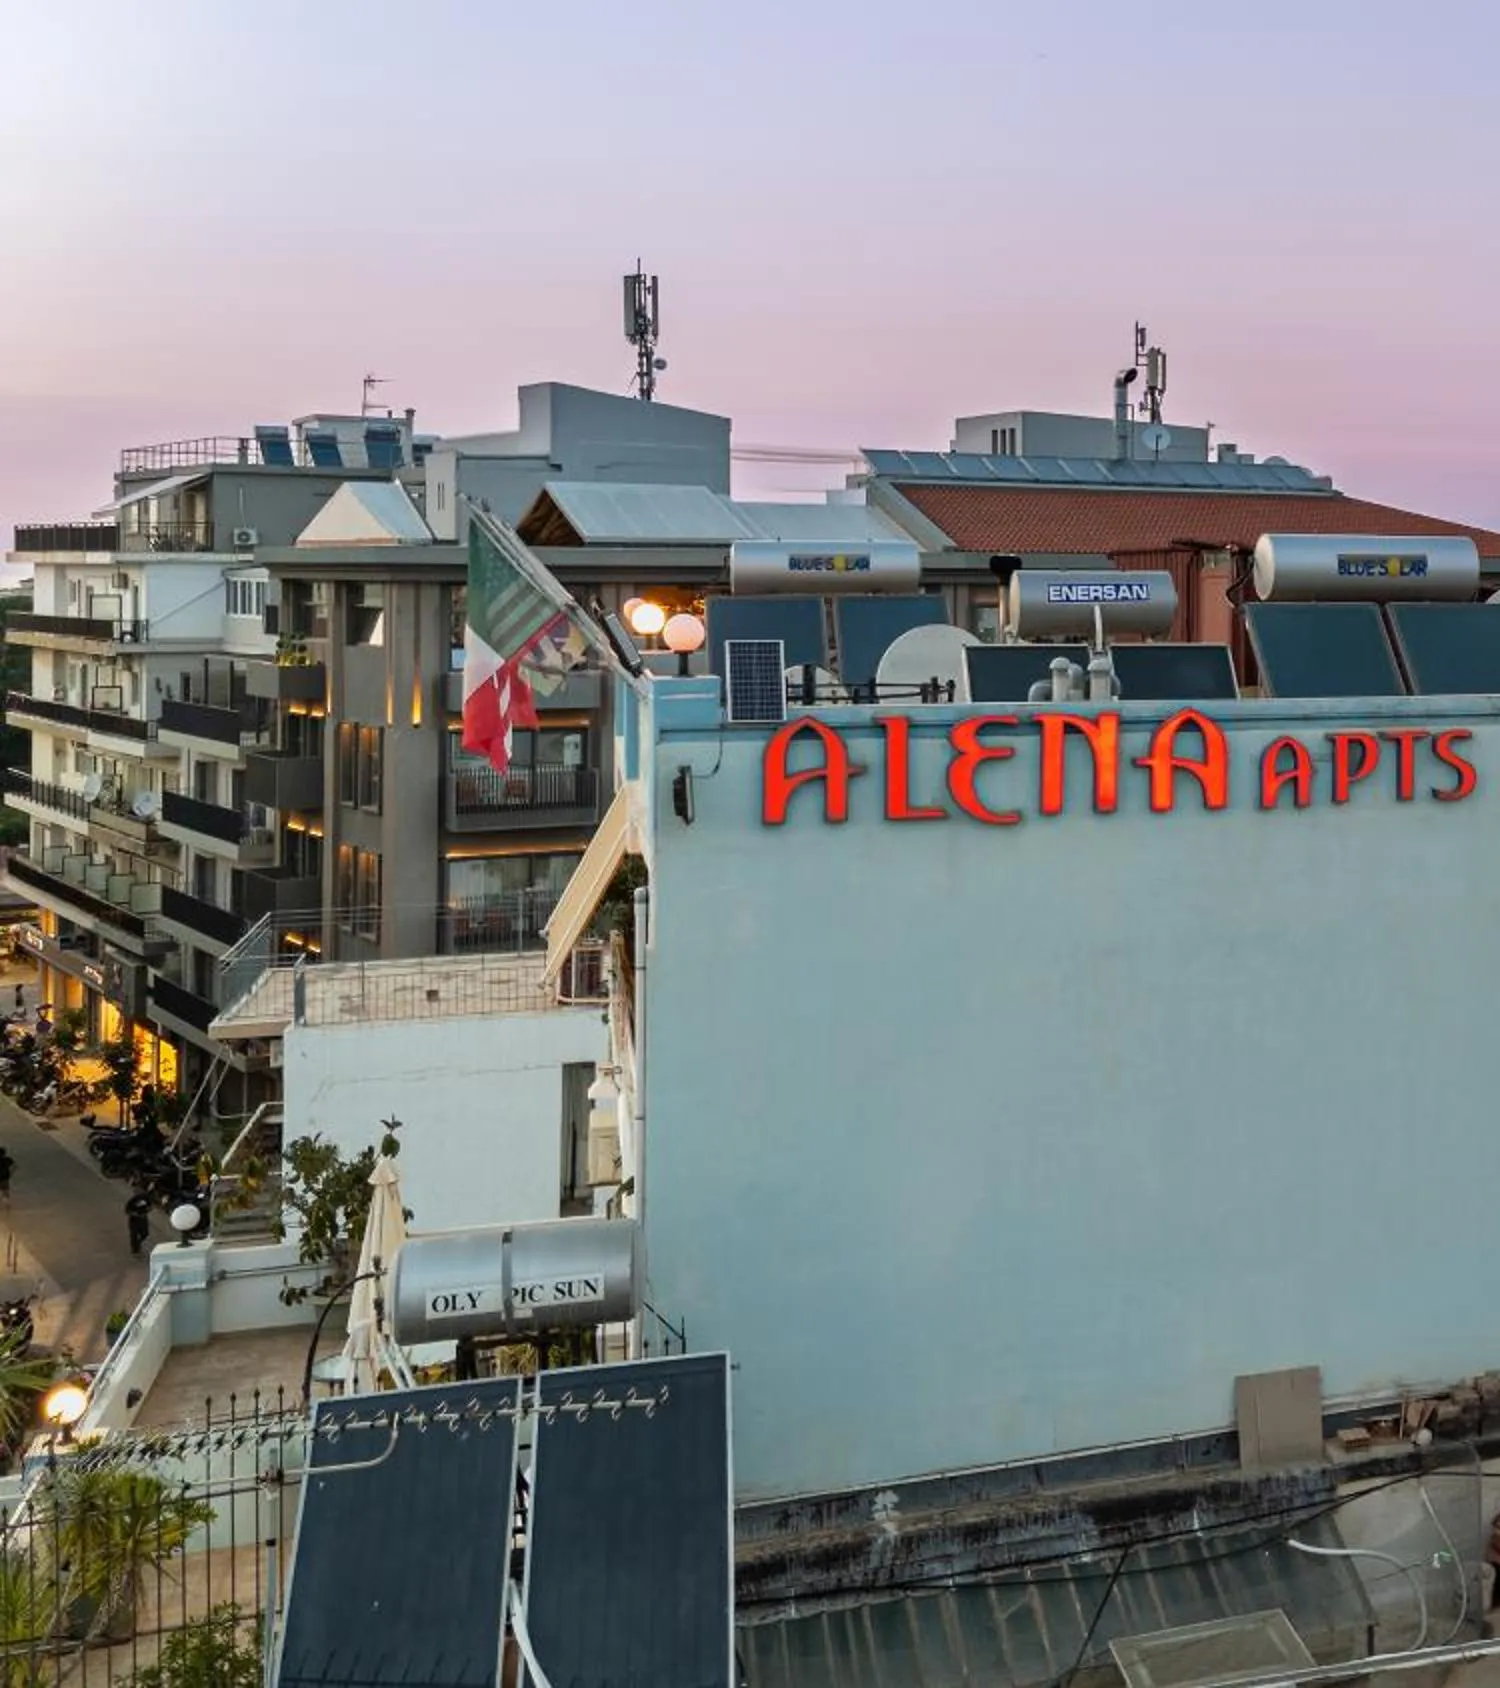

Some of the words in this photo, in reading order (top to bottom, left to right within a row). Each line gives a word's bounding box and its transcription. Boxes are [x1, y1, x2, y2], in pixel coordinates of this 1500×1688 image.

[1049, 584, 1148, 601] ENERSAN
[761, 706, 1230, 827] ALENA
[1259, 727, 1480, 810] APTS
[553, 1278, 599, 1301] SUN
